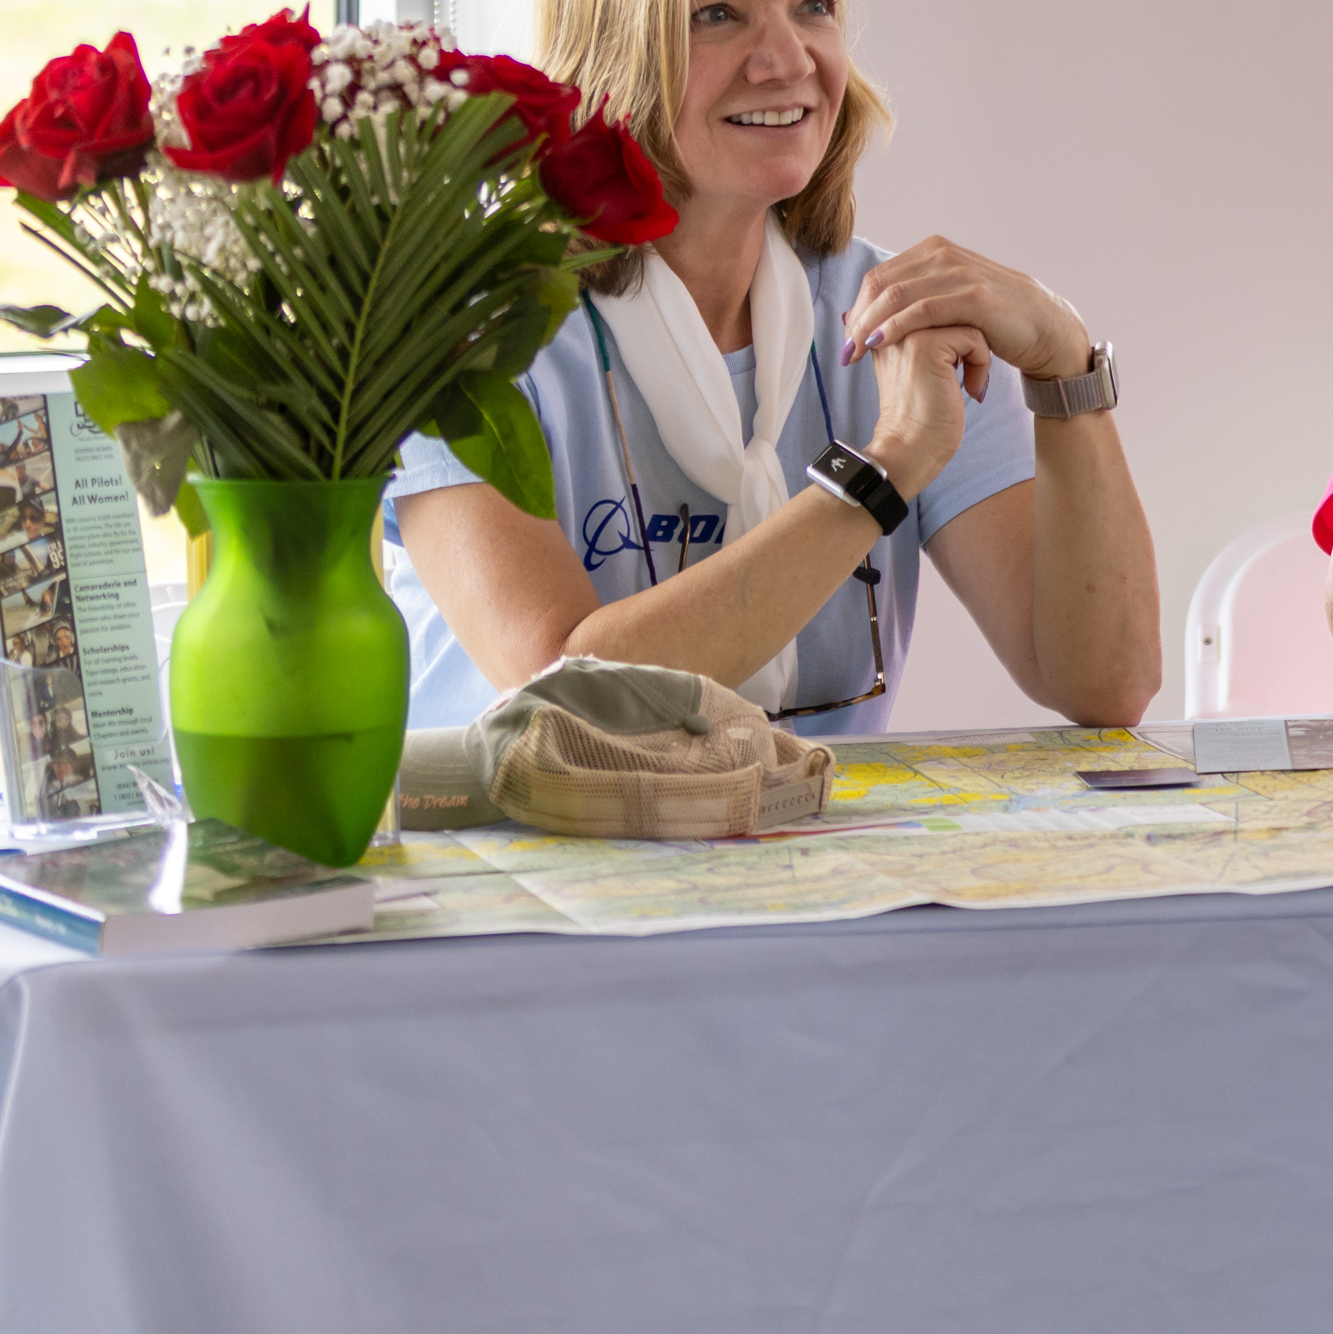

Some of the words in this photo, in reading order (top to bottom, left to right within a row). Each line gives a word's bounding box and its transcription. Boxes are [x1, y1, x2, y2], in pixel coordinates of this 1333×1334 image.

[74, 479, 88, 490] All
[91, 476, 123, 489] Pilots!
[72, 495, 85, 507] All
[88, 491, 129, 505] Women!
[646, 513, 727, 544] BO
[74, 580, 122, 593] Camaraderie
[123, 578, 137, 587] and
[75, 592, 120, 603] Networking
[82, 645, 130, 656] Scholarships
[91, 707, 134, 719] Mentorship
[114, 749, 136, 761] Join
[139, 746, 155, 757] us!
